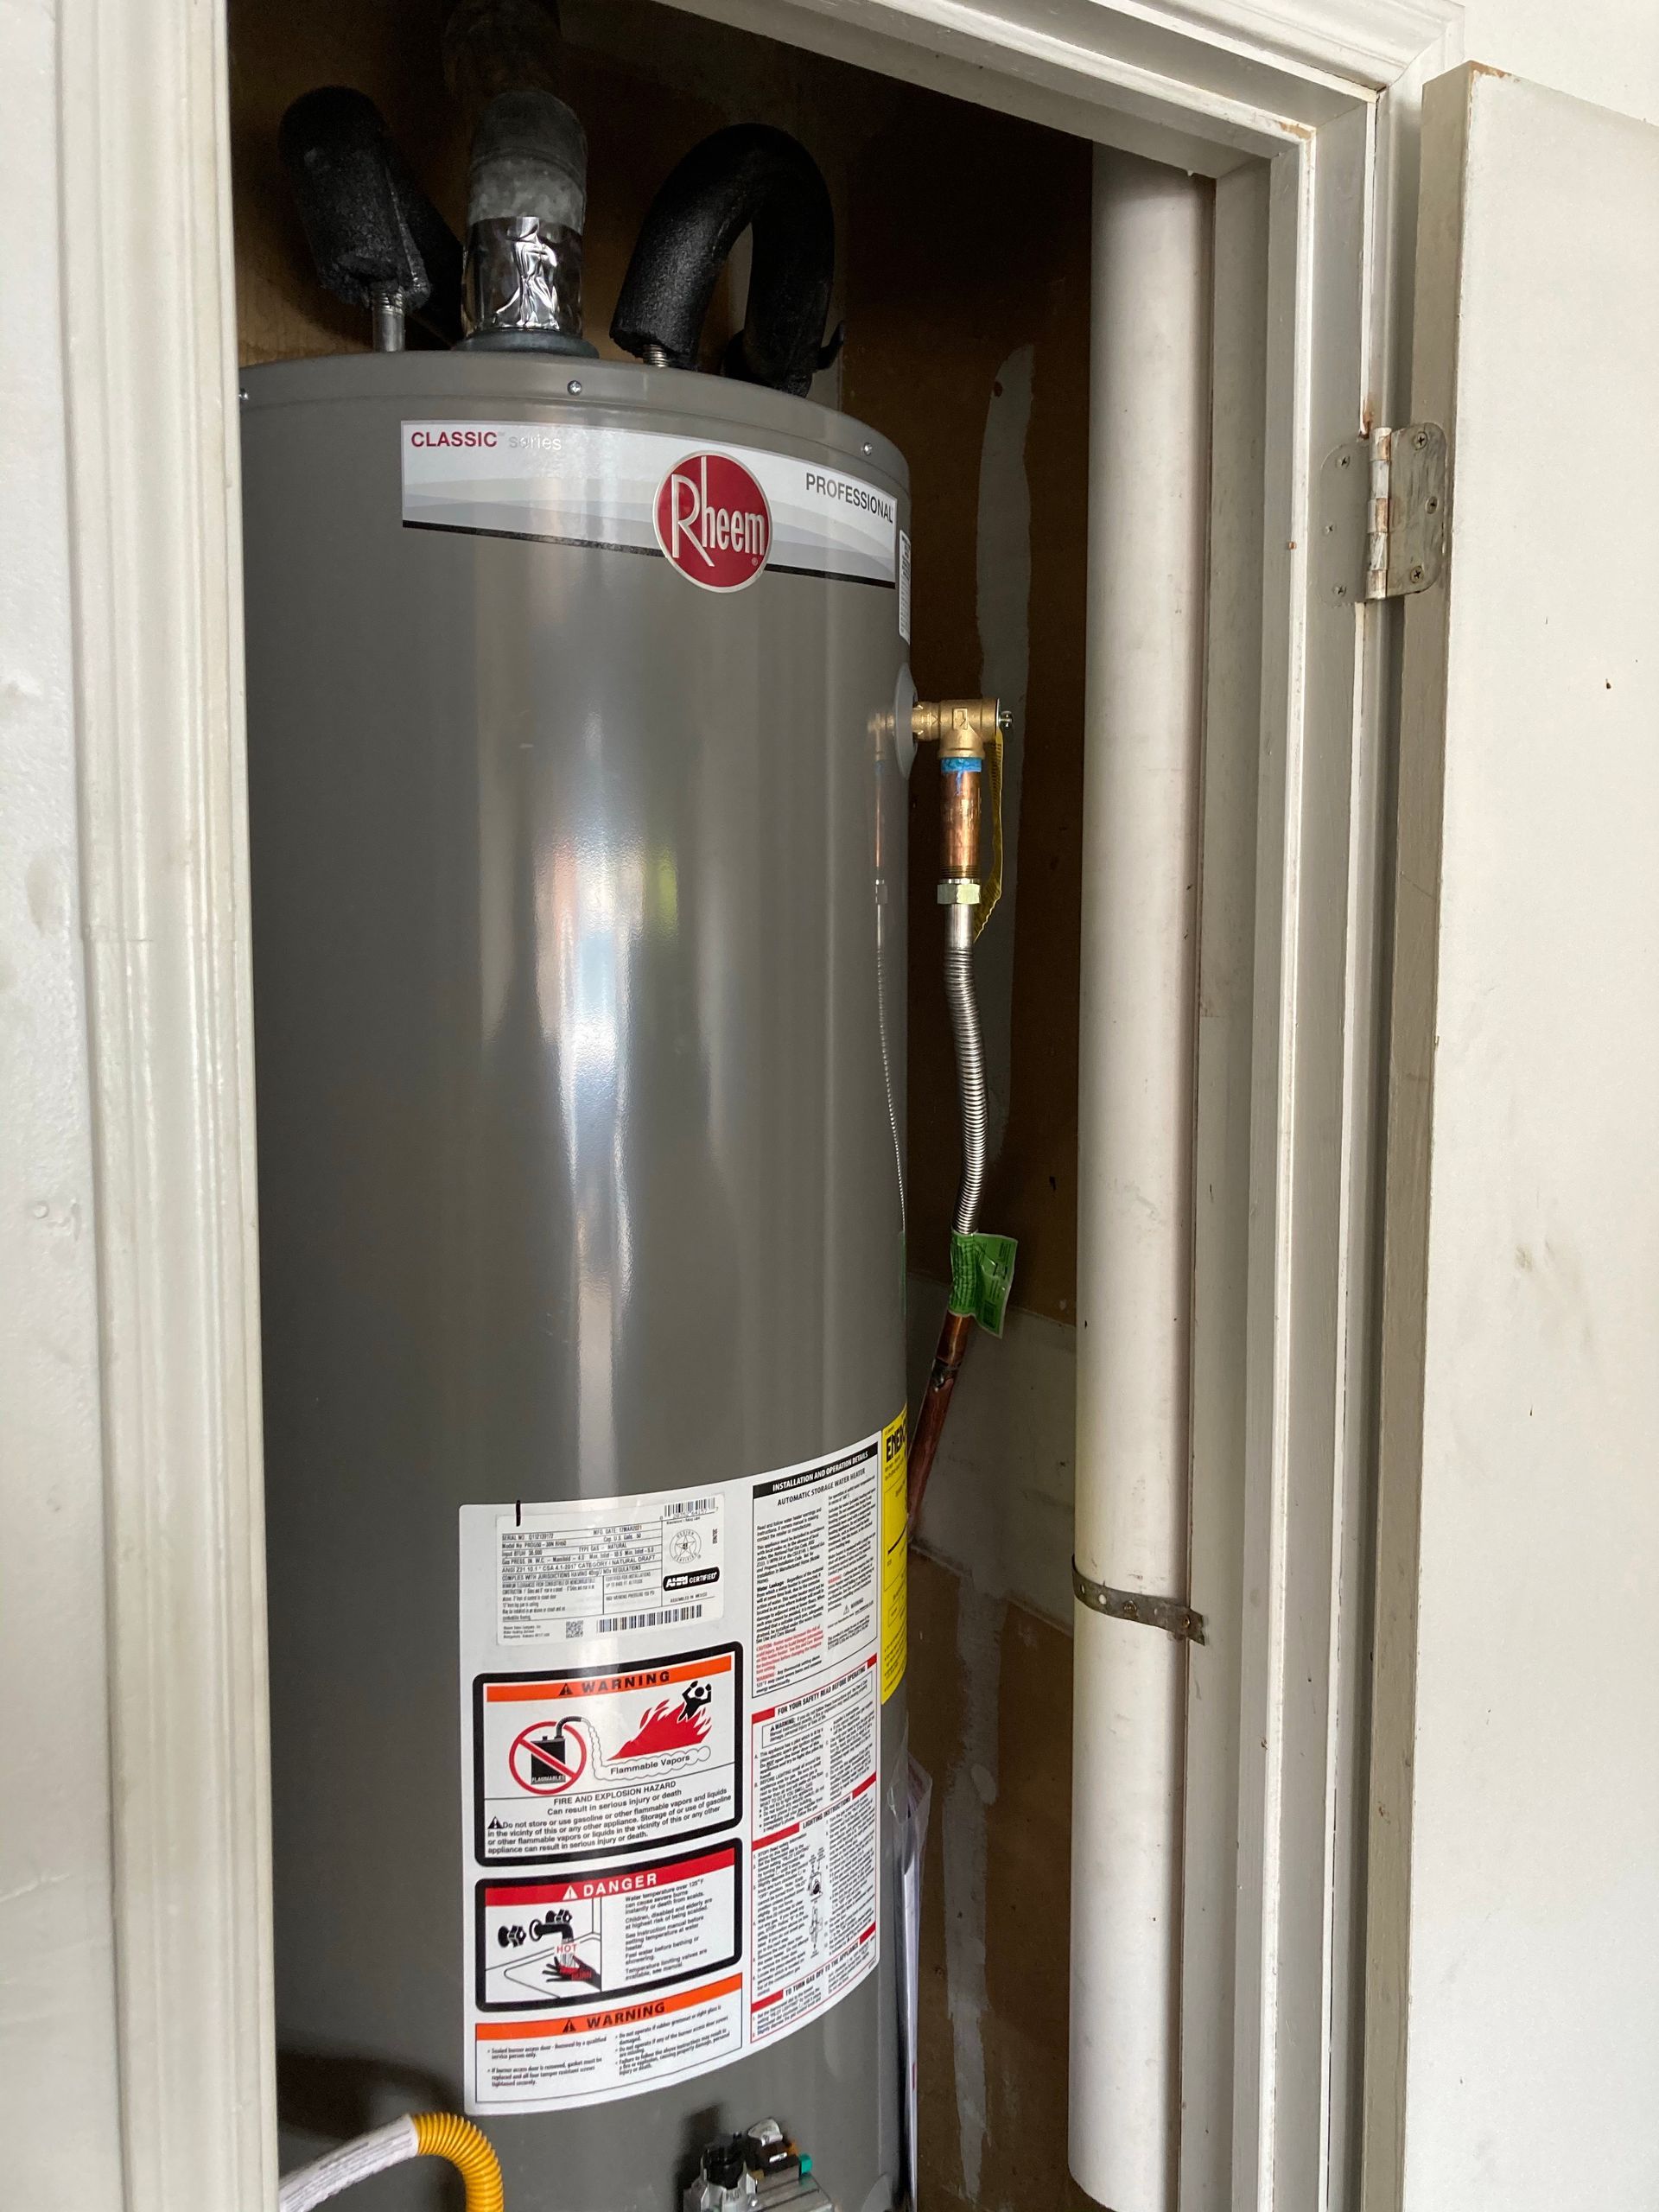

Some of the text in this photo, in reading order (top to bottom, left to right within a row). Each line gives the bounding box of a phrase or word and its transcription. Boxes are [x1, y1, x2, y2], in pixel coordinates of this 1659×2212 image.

[410, 431, 498, 448] CLASSIC
[509, 436, 562, 449] series
[806, 472, 893, 524] PROFESSIONAL
[671, 454, 766, 568] Rheem
[772, 1452, 868, 1491] INSTALLATION AND OPERATION DETAILS
[778, 1468, 865, 1506] AUTOMATIC STORAGE WATER HEATER
[581, 1670, 670, 1693] WARNING
[778, 1668, 866, 1715] FOR YOUR SAFETY READ BEFORE OPERATING
[611, 1755, 690, 1775] Flammable Vapors
[554, 1781, 677, 1806] FIRE AND EXPLOSION HAZARD
[565, 1805, 588, 1814] result
[599, 1800, 627, 1810] serious
[629, 1795, 650, 1805] injury
[662, 1789, 682, 1799] death
[574, 1815, 603, 1825] gasoline
[633, 1803, 669, 1815] flammable
[671, 1798, 692, 1808] vapors
[708, 1788, 728, 1798] liquids
[604, 1817, 639, 1828] appliance.
[640, 1812, 667, 1821] Storage
[706, 1795, 732, 1806] gasoline
[803, 1795, 850, 1829] LIGHTING INSTRUCTIONS
[488, 1846, 523, 1854] appliance
[539, 1842, 560, 1851] result
[597, 1836, 616, 1845] injury
[626, 1831, 648, 1840] death.
[556, 1834, 581, 1842] vapors
[592, 1828, 614, 1839] liquids
[583, 1872, 657, 1897] DANGER
[643, 1887, 675, 1898] temperature
[626, 1906, 648, 1915] instantly
[652, 1908, 674, 1918] disabled
[686, 1901, 703, 1910] elderly
[632, 1920, 652, 1929] highest
[637, 1926, 666, 1936] instruction
[667, 1920, 686, 1929] manual
[556, 1943, 577, 1954] HOT
[786, 1987, 791, 1996] TO
[793, 1980, 805, 1992] TURN
[806, 1974, 815, 1985] GAS
[840, 1942, 859, 1961] APPLIANCE
[587, 2001, 665, 2029] WARNING
